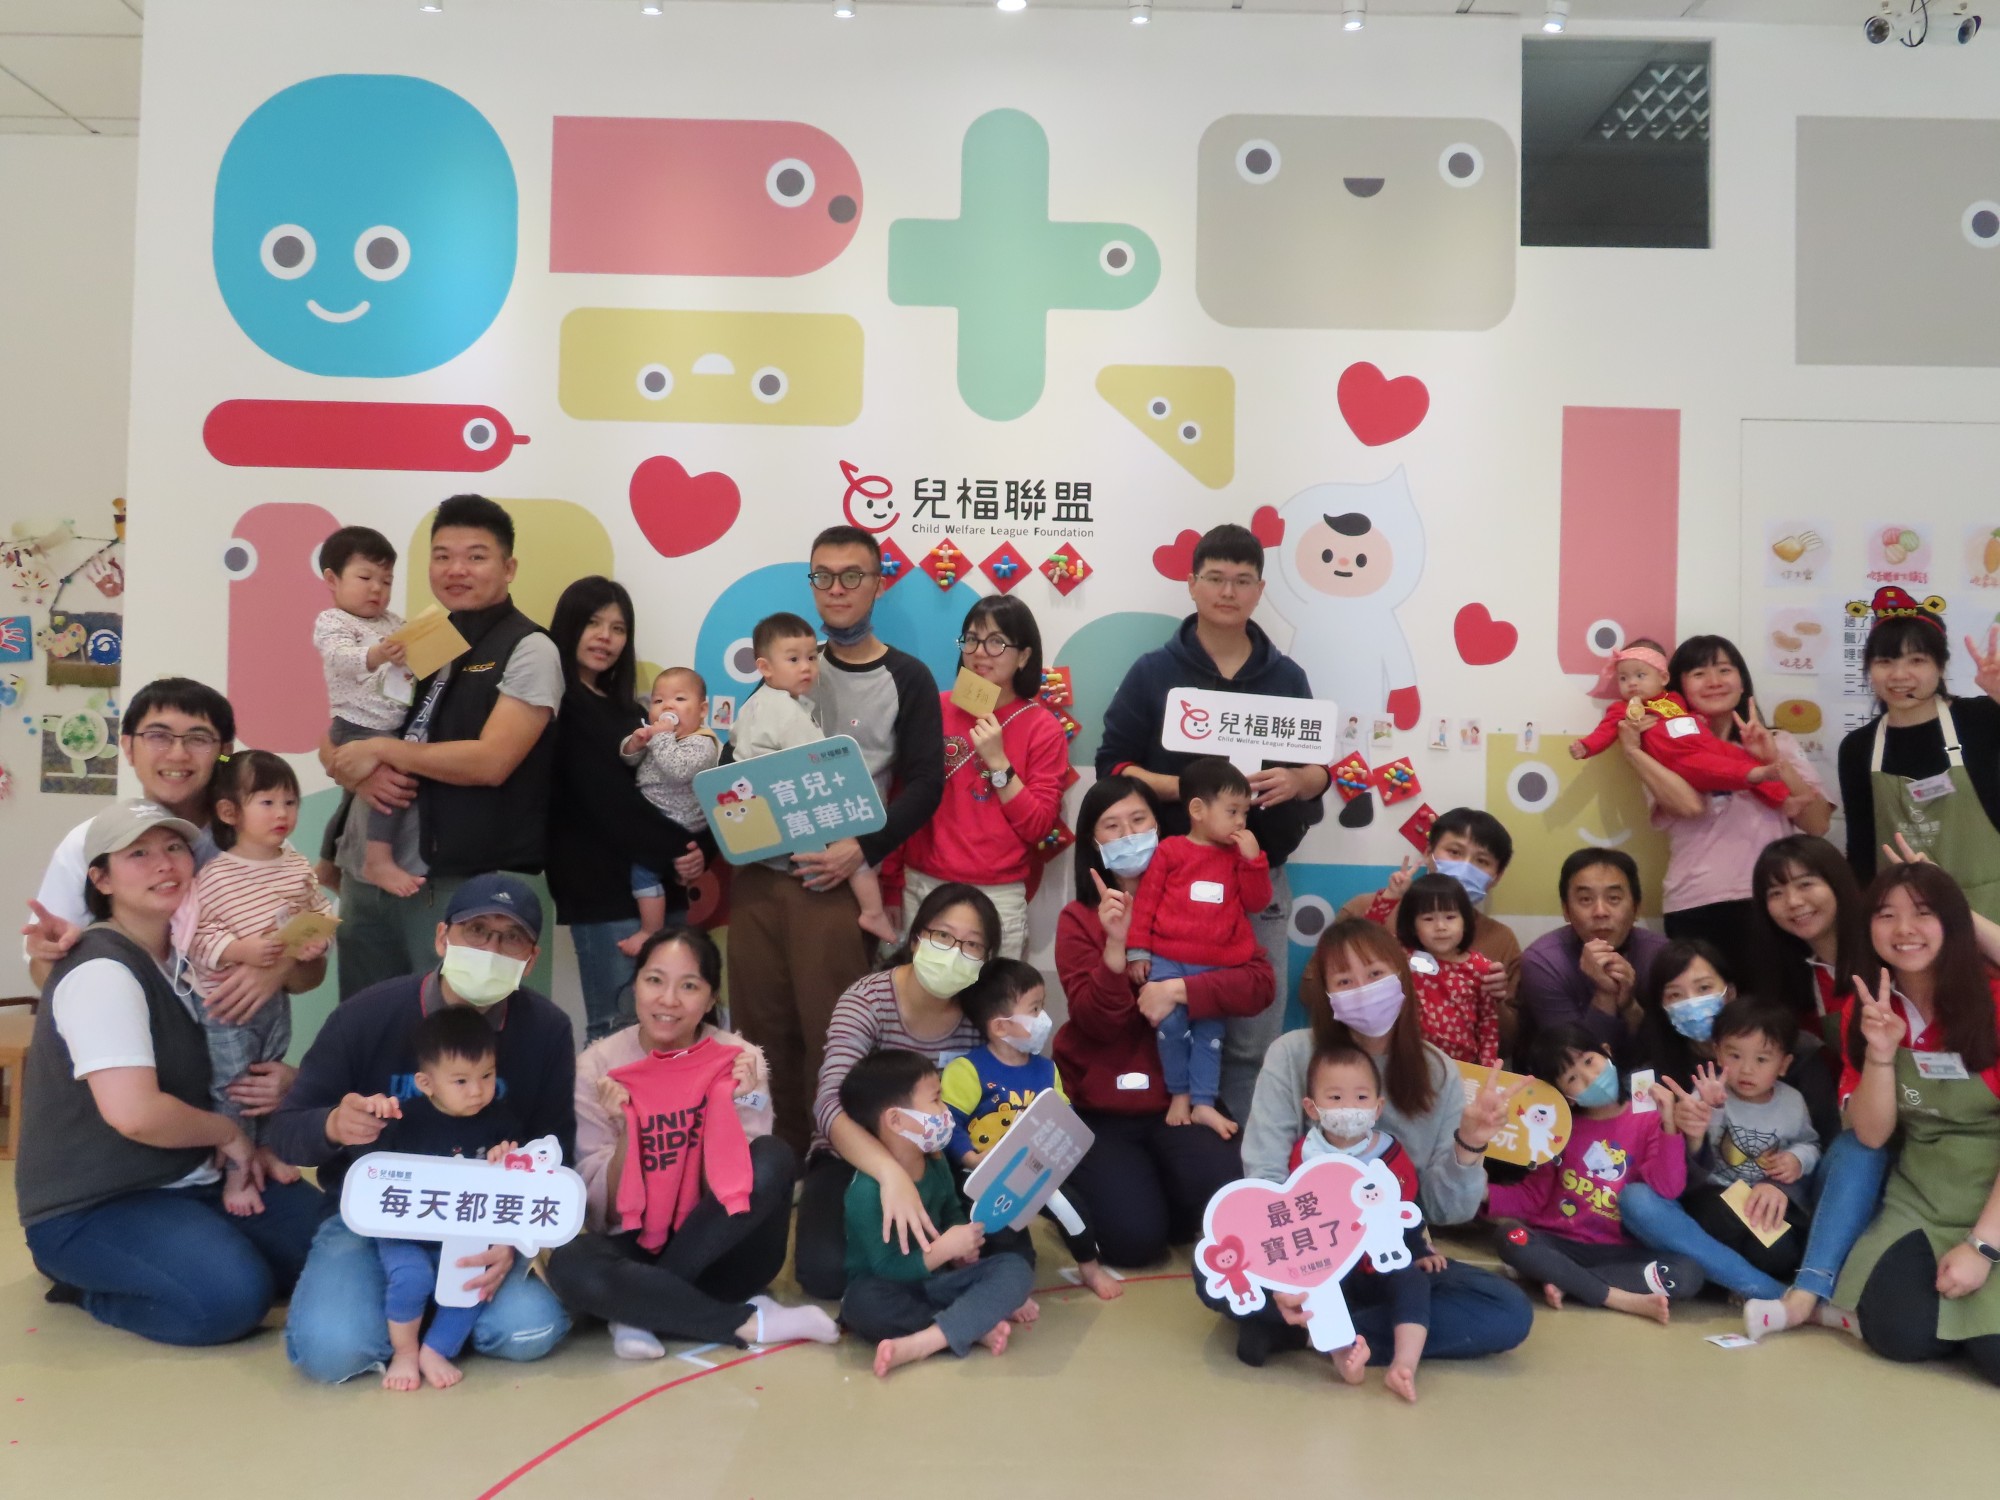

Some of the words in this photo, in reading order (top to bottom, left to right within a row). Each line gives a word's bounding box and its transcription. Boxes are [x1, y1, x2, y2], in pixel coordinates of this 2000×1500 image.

[912, 477, 1094, 522] 兒福聯盟
[911, 523, 940, 534] Child
[945, 524, 986, 535] Welfare
[990, 526, 1029, 538] League
[1034, 527, 1094, 538] Foundation
[1218, 711, 1323, 743] 兒福聯盟
[1236, 737, 1260, 745] Welfare
[1262, 739, 1284, 748] League
[1286, 742, 1322, 750] Foundation
[782, 795, 875, 839] 萬華站
[643, 1151, 678, 1172] OF
[379, 1185, 561, 1228] 每天都要來
[1562, 1168, 1619, 1210] SPAC
[1267, 1191, 1322, 1229] 最愛
[1260, 1220, 1341, 1265] 寶貝了
